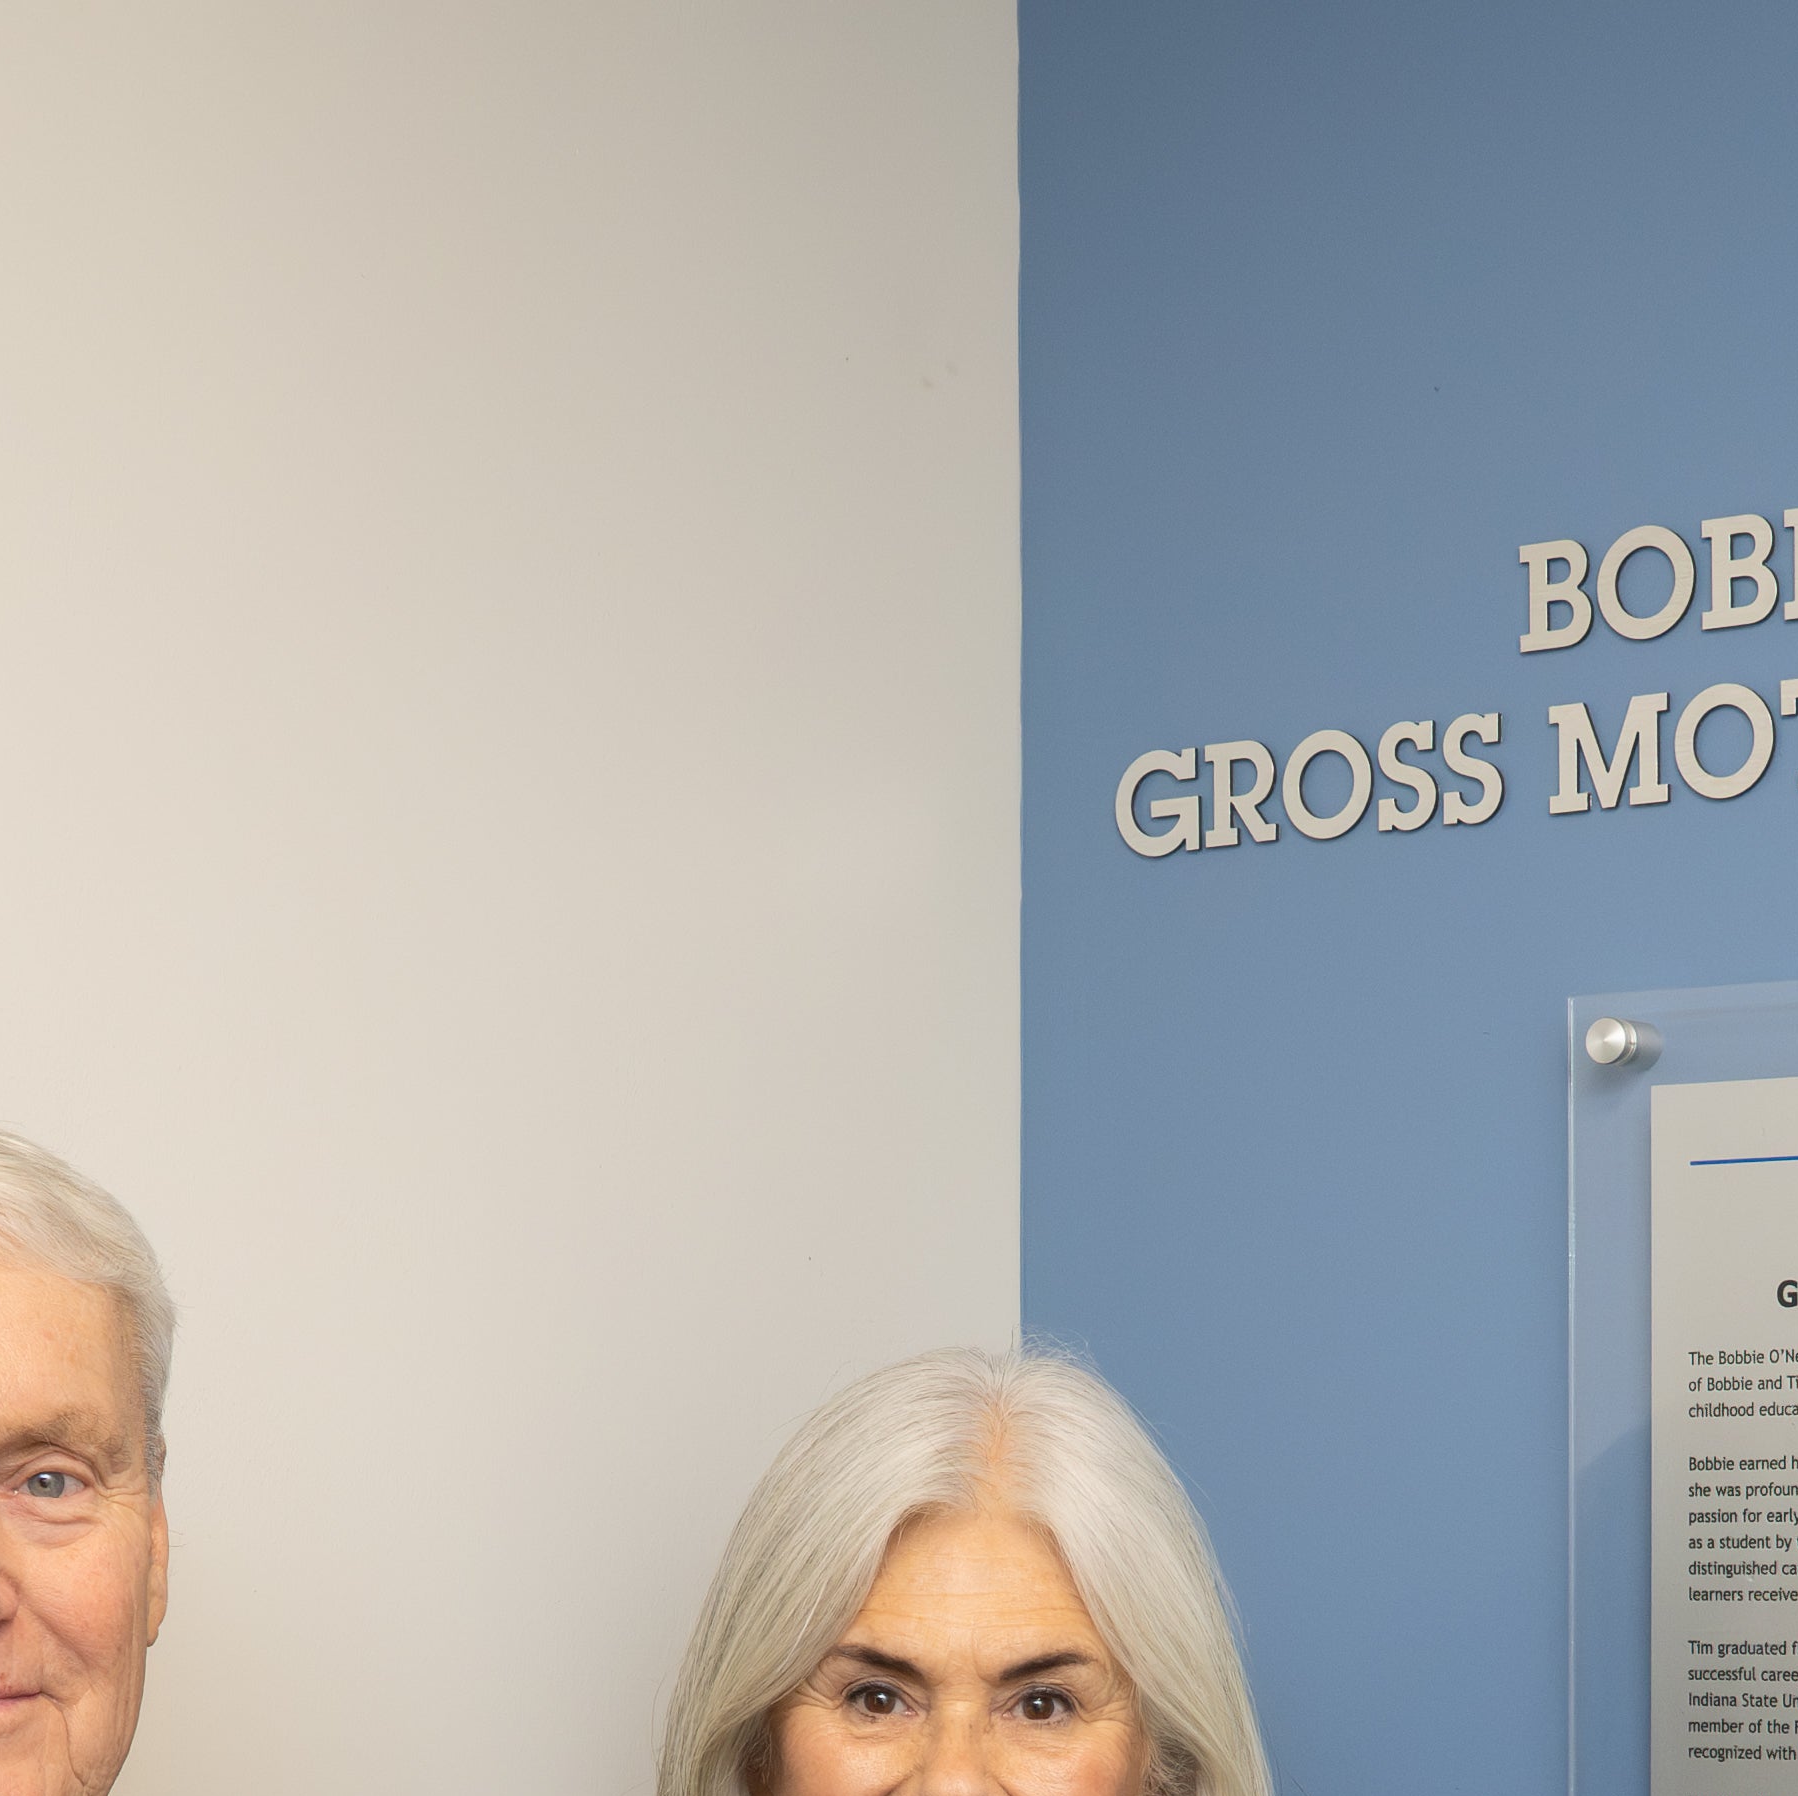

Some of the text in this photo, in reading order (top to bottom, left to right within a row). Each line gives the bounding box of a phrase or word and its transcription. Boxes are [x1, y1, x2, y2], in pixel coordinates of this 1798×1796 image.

[1115, 713, 1502, 856] GROSS
[1687, 1350, 1714, 1366] The
[1718, 1349, 1765, 1365] Bobbie
[1688, 1376, 1703, 1392] of
[1707, 1375, 1753, 1392] Bobbie
[1757, 1374, 1783, 1390] and
[1688, 1401, 1755, 1418] childhood
[1688, 1455, 1735, 1472] Bobbie
[1738, 1454, 1787, 1470] earned
[1688, 1508, 1738, 1526] passion
[1742, 1507, 1763, 1523] for
[1688, 1559, 1778, 1579] distinguished
[1688, 1691, 1737, 1707] Indiana
[1741, 1692, 1779, 1708] State
[1688, 1744, 1762, 1763] recognized
[1765, 1745, 1797, 1761] with
